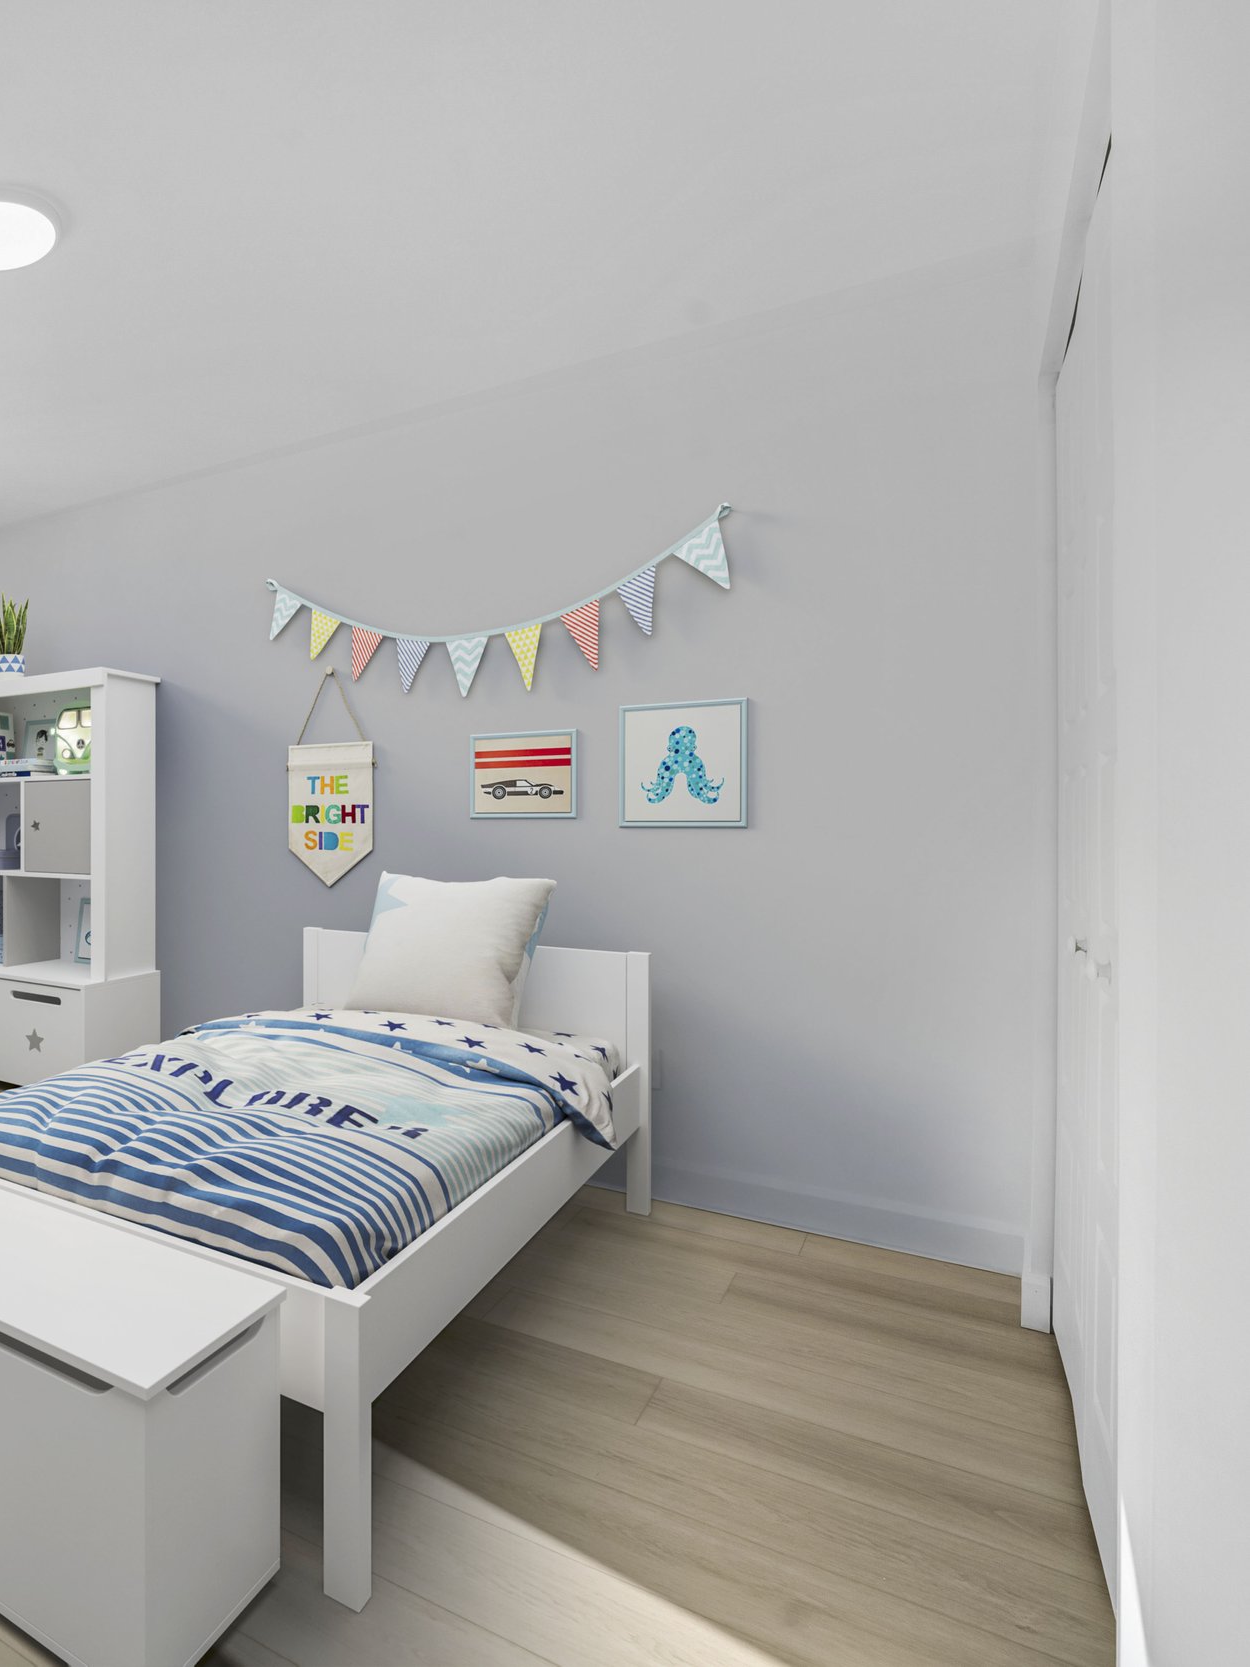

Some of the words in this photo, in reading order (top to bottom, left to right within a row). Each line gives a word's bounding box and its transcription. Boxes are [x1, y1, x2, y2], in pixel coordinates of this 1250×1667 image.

[307, 775, 349, 795] THE
[291, 804, 369, 824] BRIGHT
[304, 830, 354, 851] SIDE
